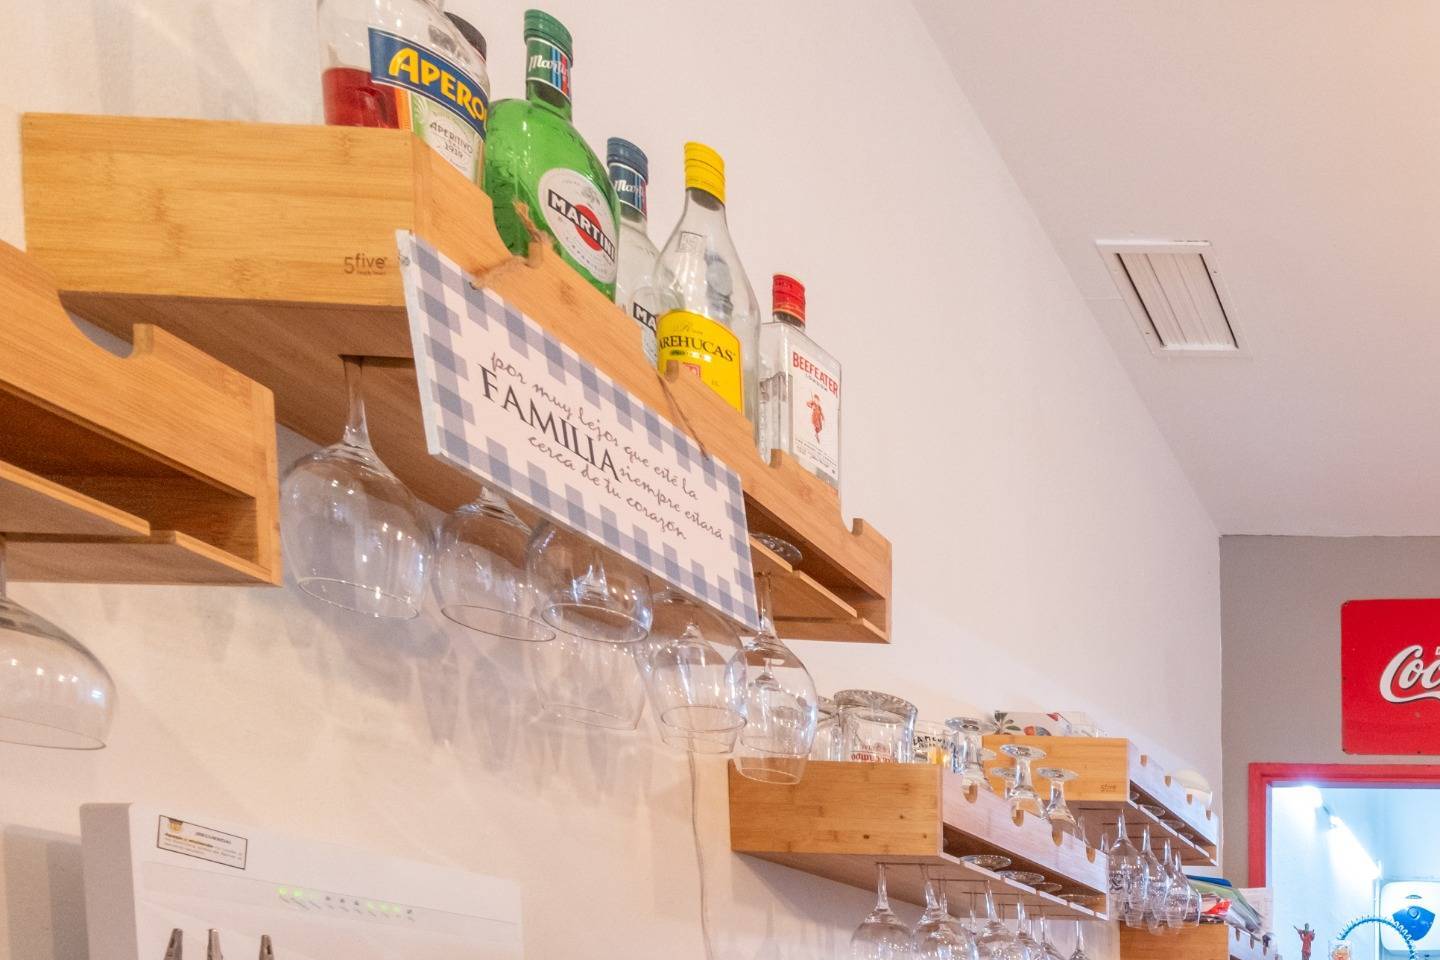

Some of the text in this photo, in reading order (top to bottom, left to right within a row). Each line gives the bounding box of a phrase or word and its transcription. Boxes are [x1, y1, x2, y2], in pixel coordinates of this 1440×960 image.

[388, 47, 488, 122] APERO
[550, 192, 615, 261] MARTINI
[792, 351, 838, 398] BEEFEATER
[477, 363, 724, 540] FAMILIA siempre estará
[490, 352, 526, 385] por
[532, 382, 573, 420] muy
[578, 406, 618, 446] lejos
[624, 446, 650, 468] que
[682, 476, 699, 501] la
[528, 435, 687, 540] cerca de tu corazón
